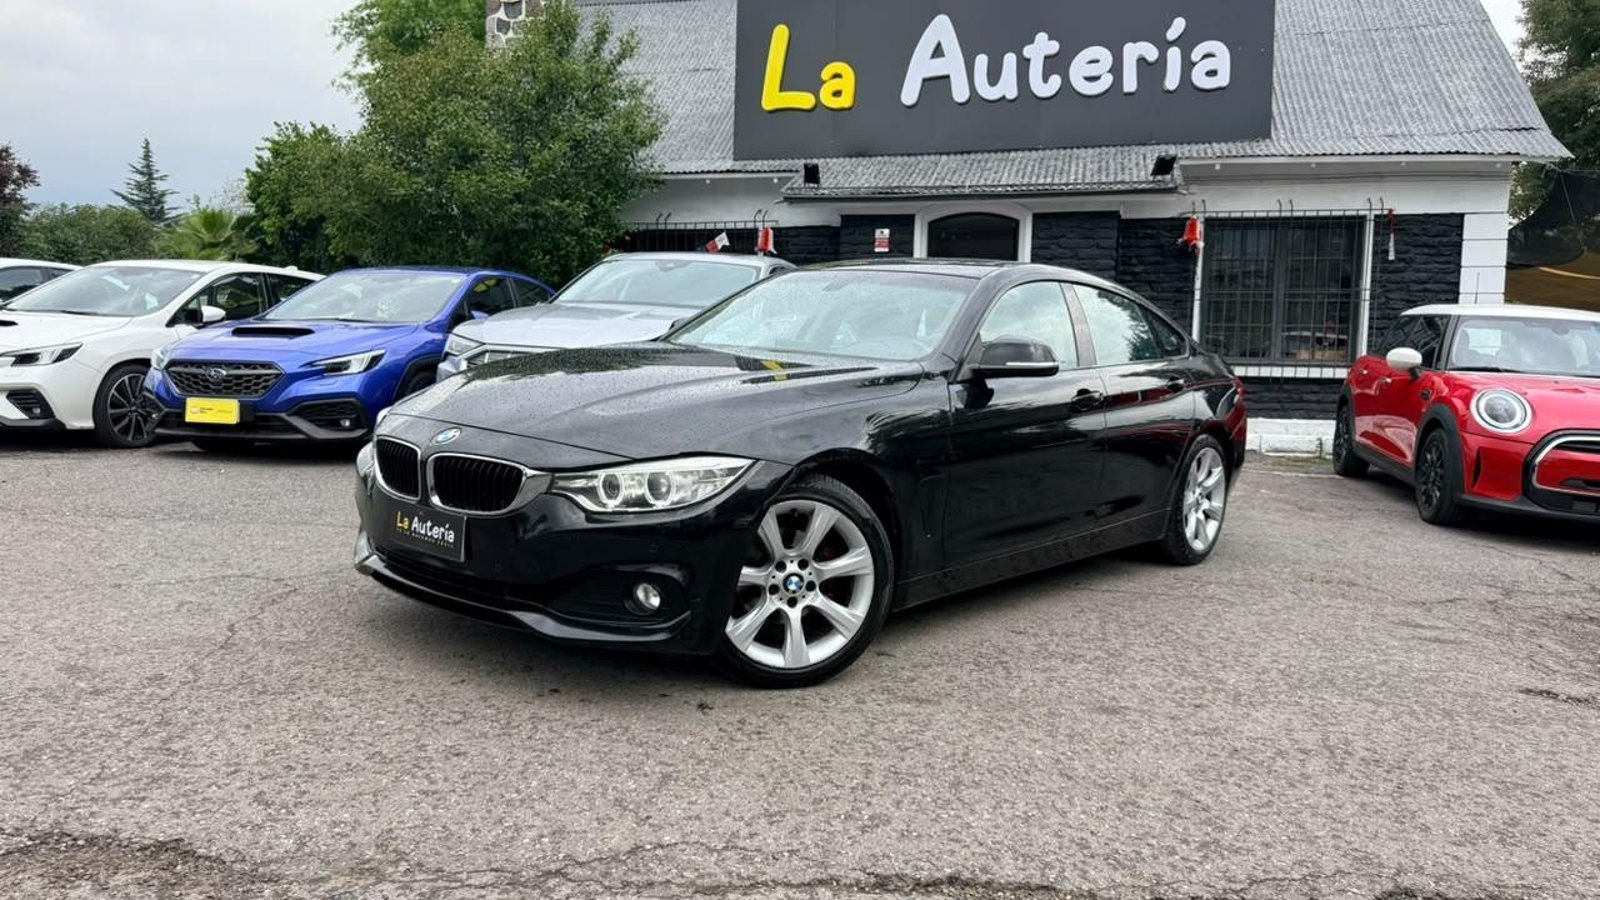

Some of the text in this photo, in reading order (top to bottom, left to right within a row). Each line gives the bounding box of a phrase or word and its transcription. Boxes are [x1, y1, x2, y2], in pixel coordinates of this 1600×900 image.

[762, 14, 1231, 111] La Autería
[396, 511, 410, 530] La
[411, 515, 455, 543] Autería
